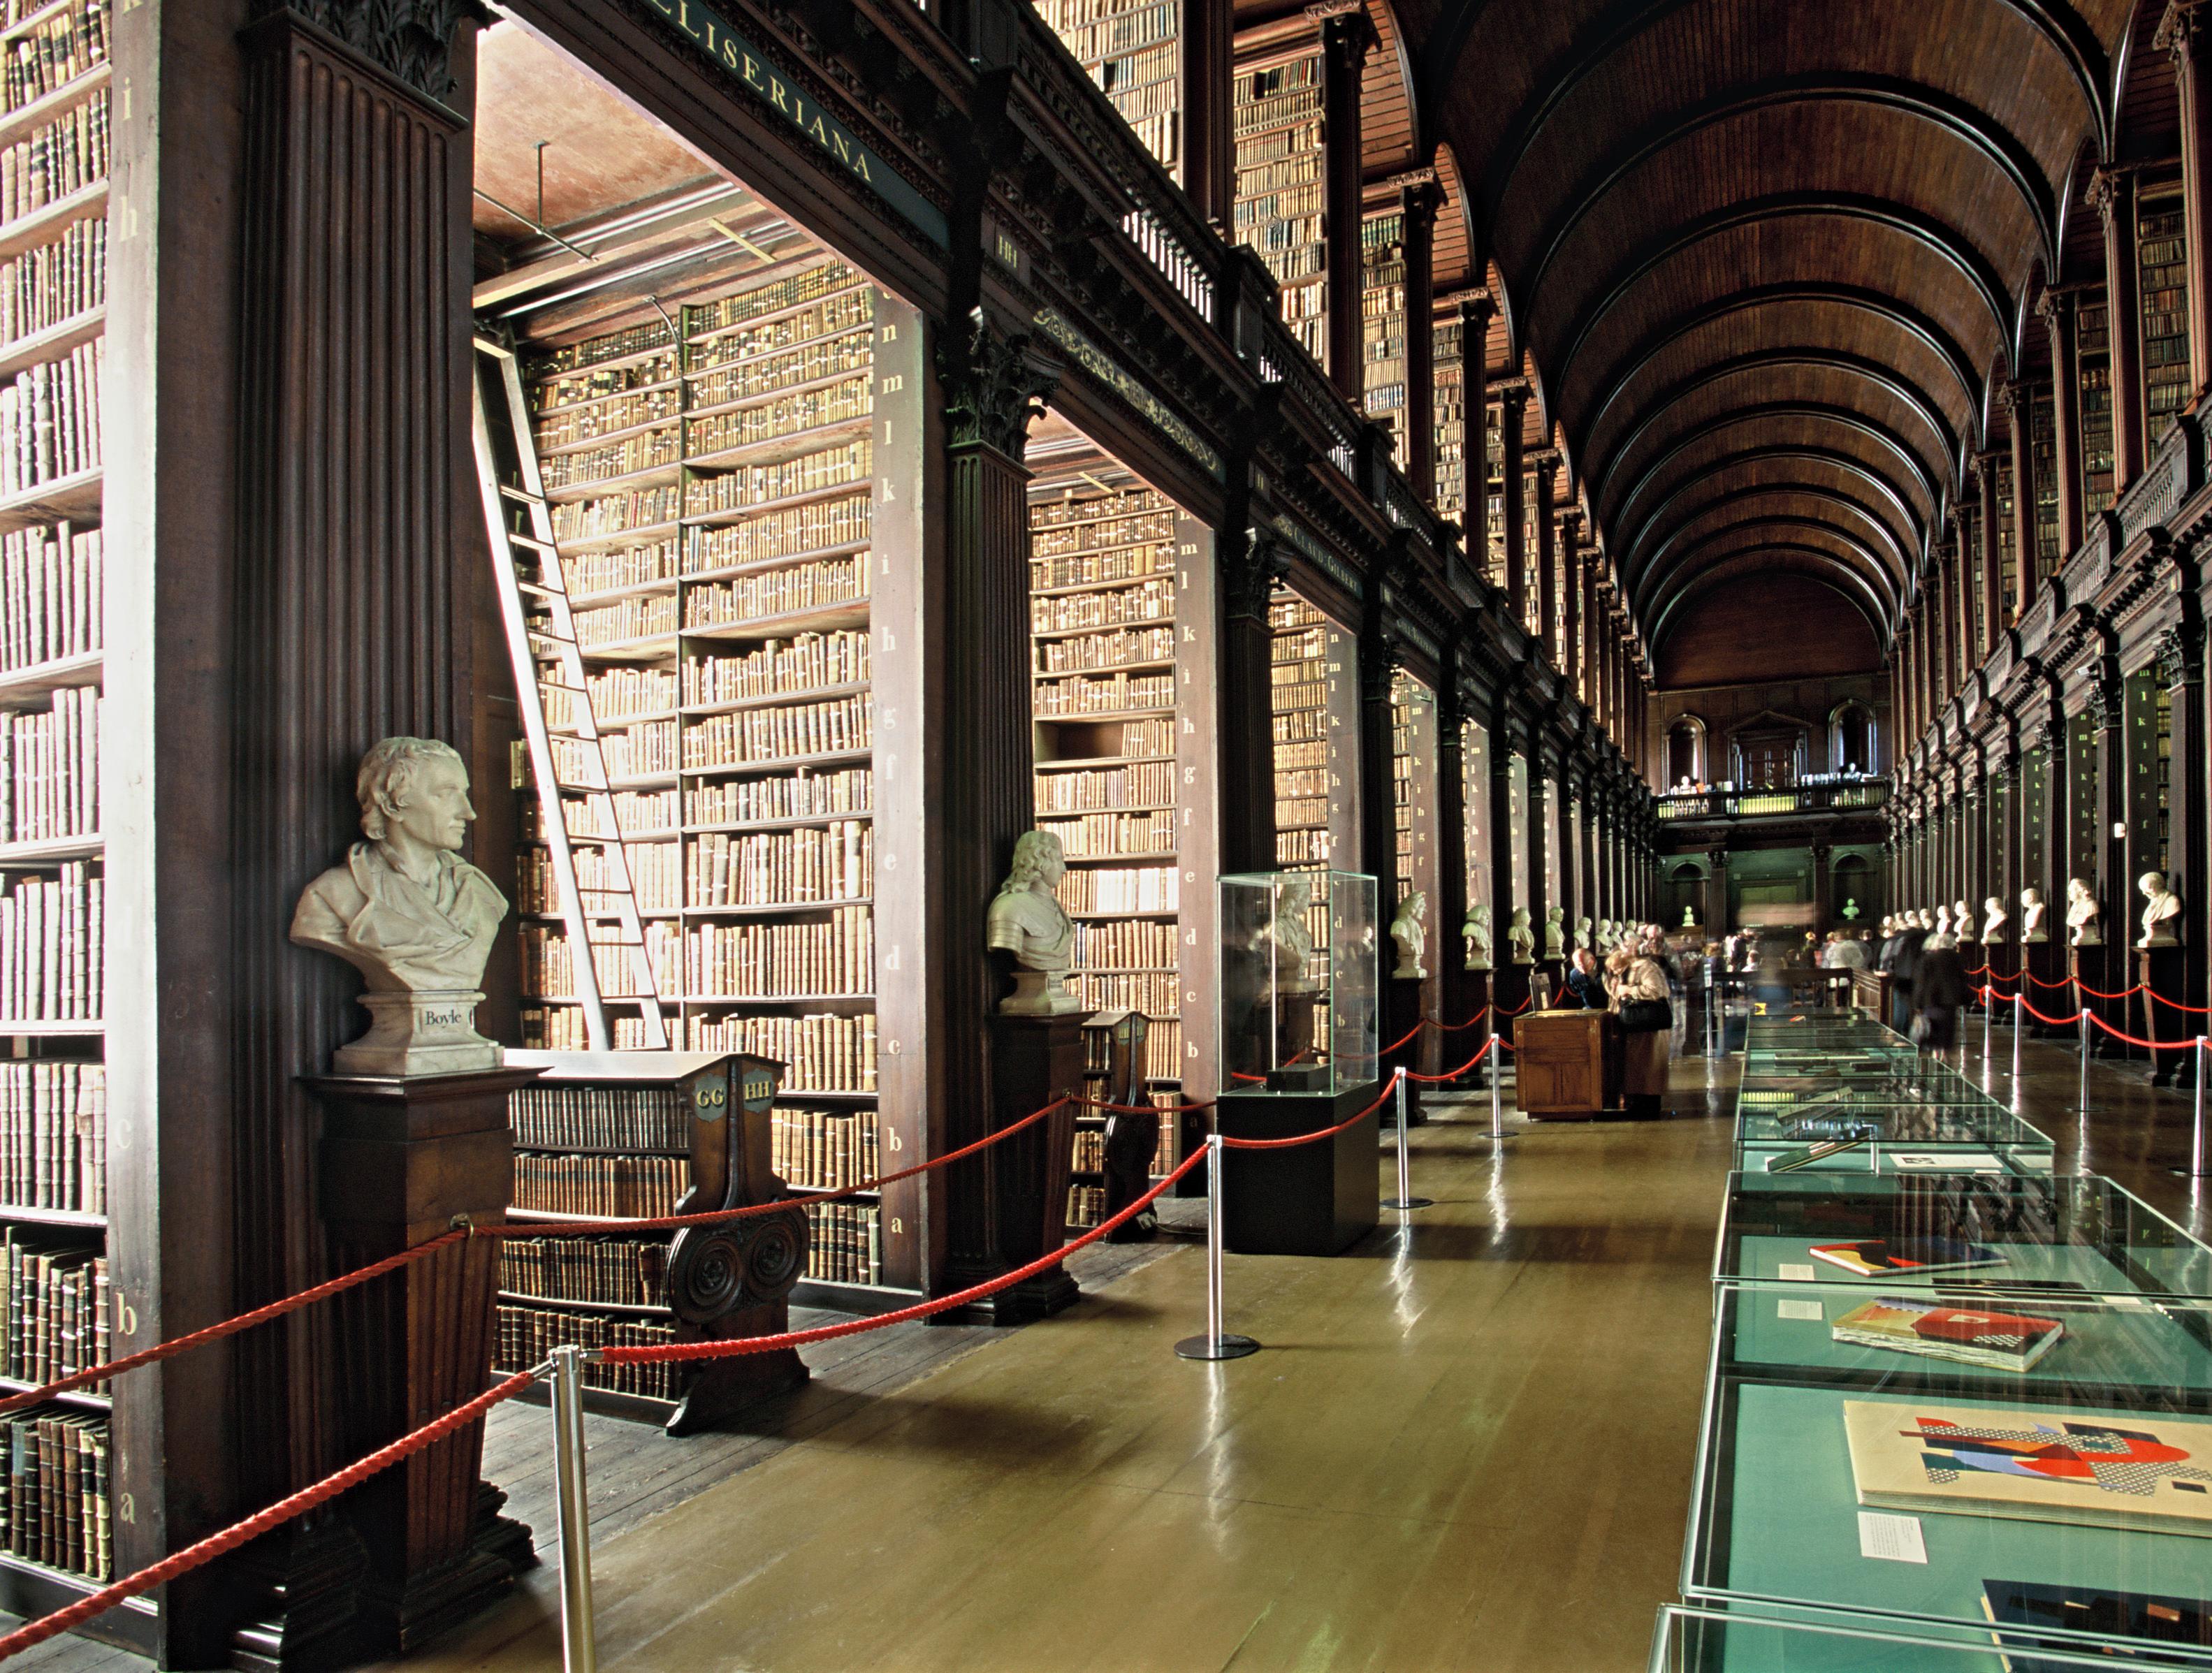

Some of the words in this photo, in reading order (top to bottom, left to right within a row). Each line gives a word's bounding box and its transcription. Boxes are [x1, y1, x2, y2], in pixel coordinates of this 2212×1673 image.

[123, 77, 131, 120] i
[119, 196, 138, 242] h
[882, 324, 897, 344] n
[882, 374, 903, 394] m
[885, 421, 892, 446] l
[882, 478, 896, 503] k
[1181, 543, 1198, 556] m
[882, 554, 890, 574] i
[1181, 571, 1188, 590] l
[882, 627, 896, 652] h
[1183, 626, 1196, 643] k
[1330, 634, 1339, 643] n
[1329, 663, 1340, 672] m
[1184, 669, 1191, 685] i
[1330, 680, 1336, 692] l
[883, 707, 897, 729] g
[1412, 707, 1421, 715] m
[1183, 717, 1195, 735] h
[1332, 716, 1340, 726] k
[2138, 717, 2146, 726] k
[1332, 746, 1336, 757] i
[2143, 740, 2146, 749] i
[885, 754, 897, 780] f
[1414, 757, 1421, 766] k
[2139, 764, 2148, 774] h
[1184, 766, 1196, 784] g
[1332, 774, 1340, 787] h
[1417, 783, 1421, 794] i
[1472, 784, 1478, 794] k
[1184, 808, 1192, 826] f
[1418, 808, 1424, 816] h
[1472, 825, 1478, 835] h
[1332, 835, 1339, 847] f
[884, 854, 897, 870] e
[1185, 872, 1195, 883] e
[1334, 916, 1343, 928] d
[1186, 928, 1196, 944] d
[885, 945, 900, 970] d
[1336, 970, 1343, 979] c
[1186, 991, 1196, 1003] c
[425, 1009, 461, 1028] Boyle
[1337, 1014, 1346, 1027] b
[888, 1039, 900, 1055] c
[1188, 1042, 1199, 1058] b
[697, 1088, 724, 1106] GG
[744, 1081, 770, 1099] HH
[117, 1119, 133, 1148] c
[887, 1127, 903, 1151] b
[892, 1218, 904, 1234] a
[115, 1293, 137, 1336] b
[121, 1493, 136, 1524] a
